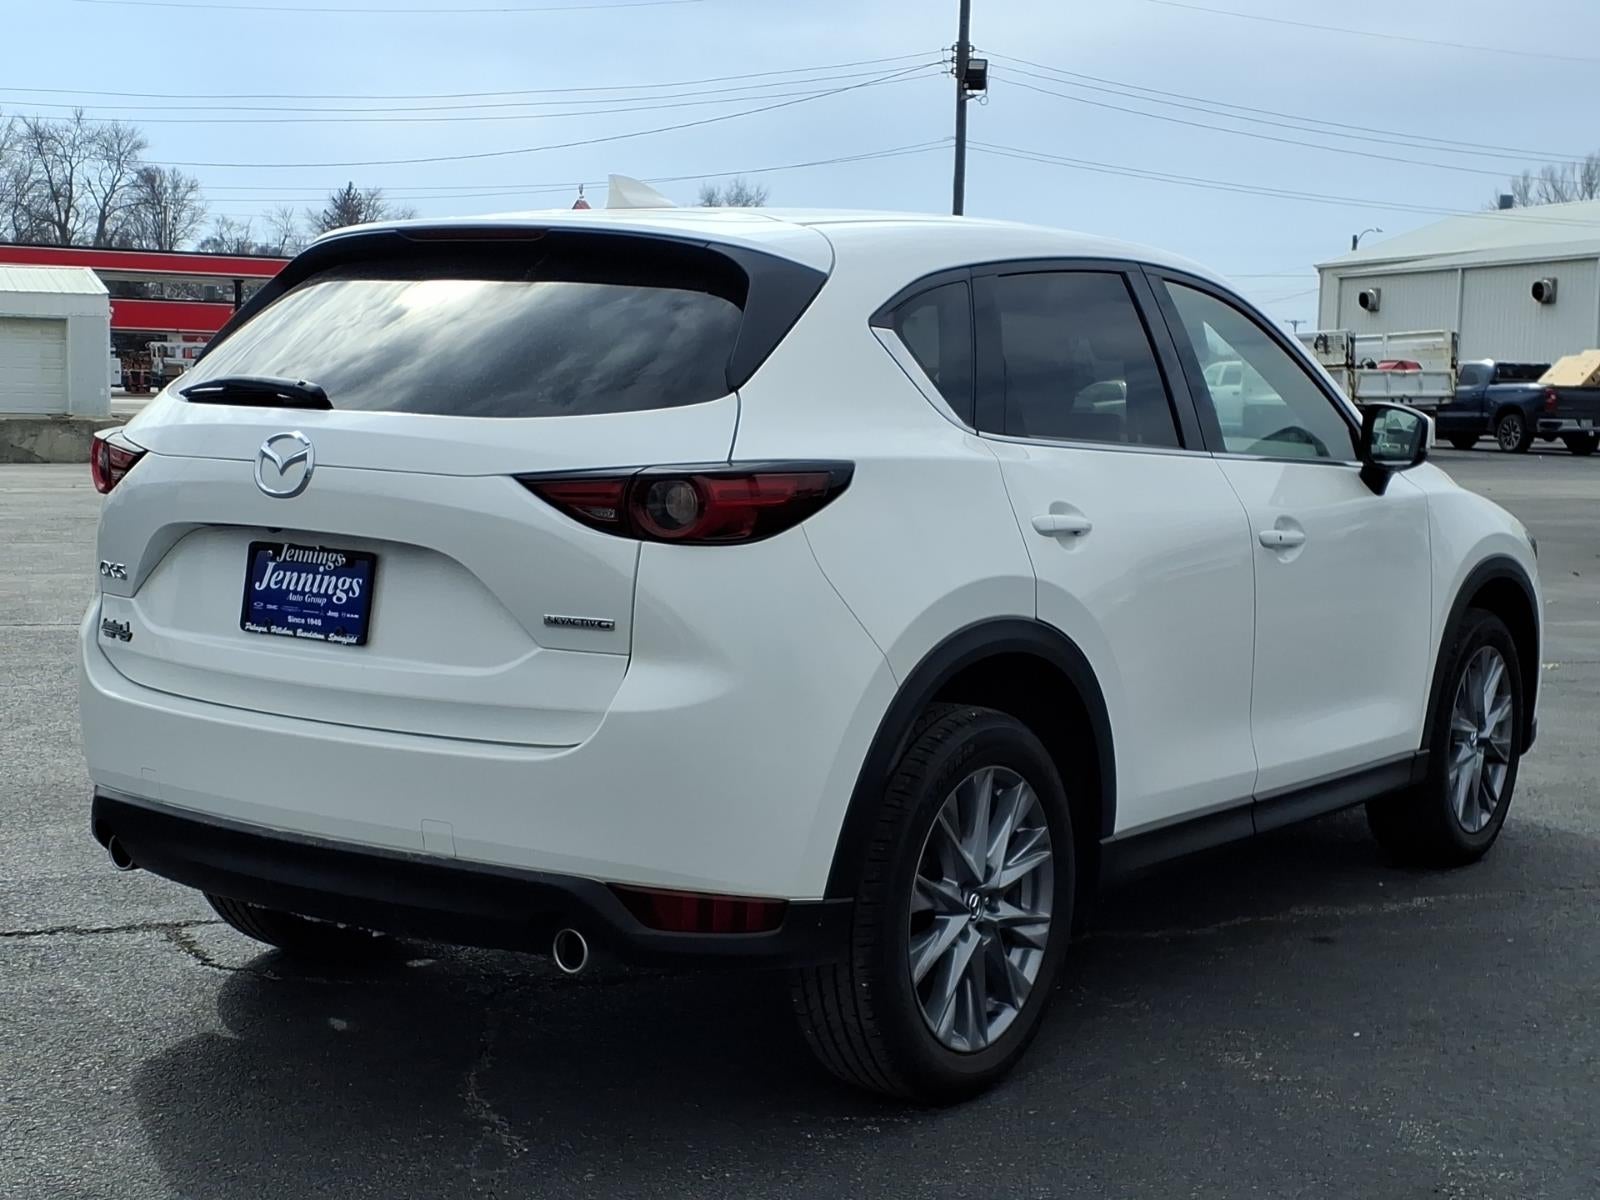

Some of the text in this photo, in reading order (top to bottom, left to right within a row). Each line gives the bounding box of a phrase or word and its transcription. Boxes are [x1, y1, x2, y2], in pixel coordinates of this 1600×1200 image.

[276, 543, 346, 571] Jennings
[255, 561, 363, 604] Jennings
[287, 592, 327, 606] Auto Group
[287, 615, 305, 625] Since
